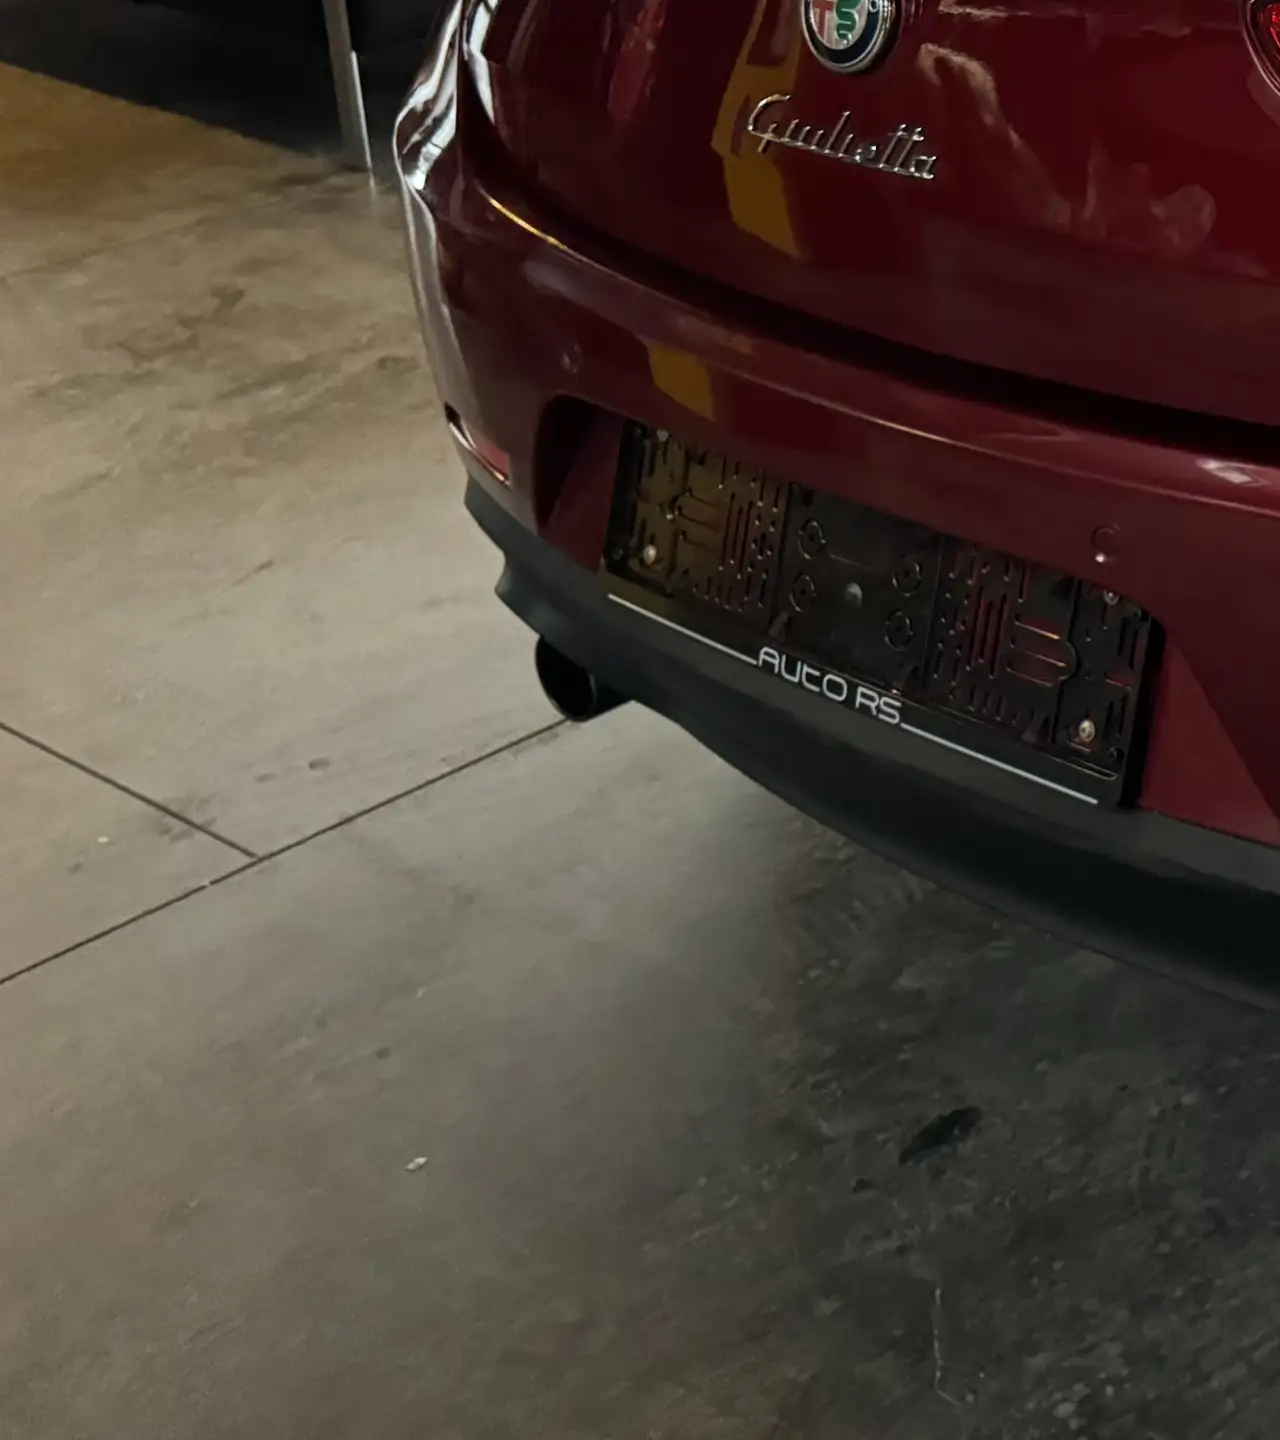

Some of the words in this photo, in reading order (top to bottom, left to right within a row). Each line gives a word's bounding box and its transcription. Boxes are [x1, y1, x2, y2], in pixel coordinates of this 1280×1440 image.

[748, 93, 937, 180] Giulietta
[758, 646, 848, 702] AUTO
[855, 686, 902, 725] RS
